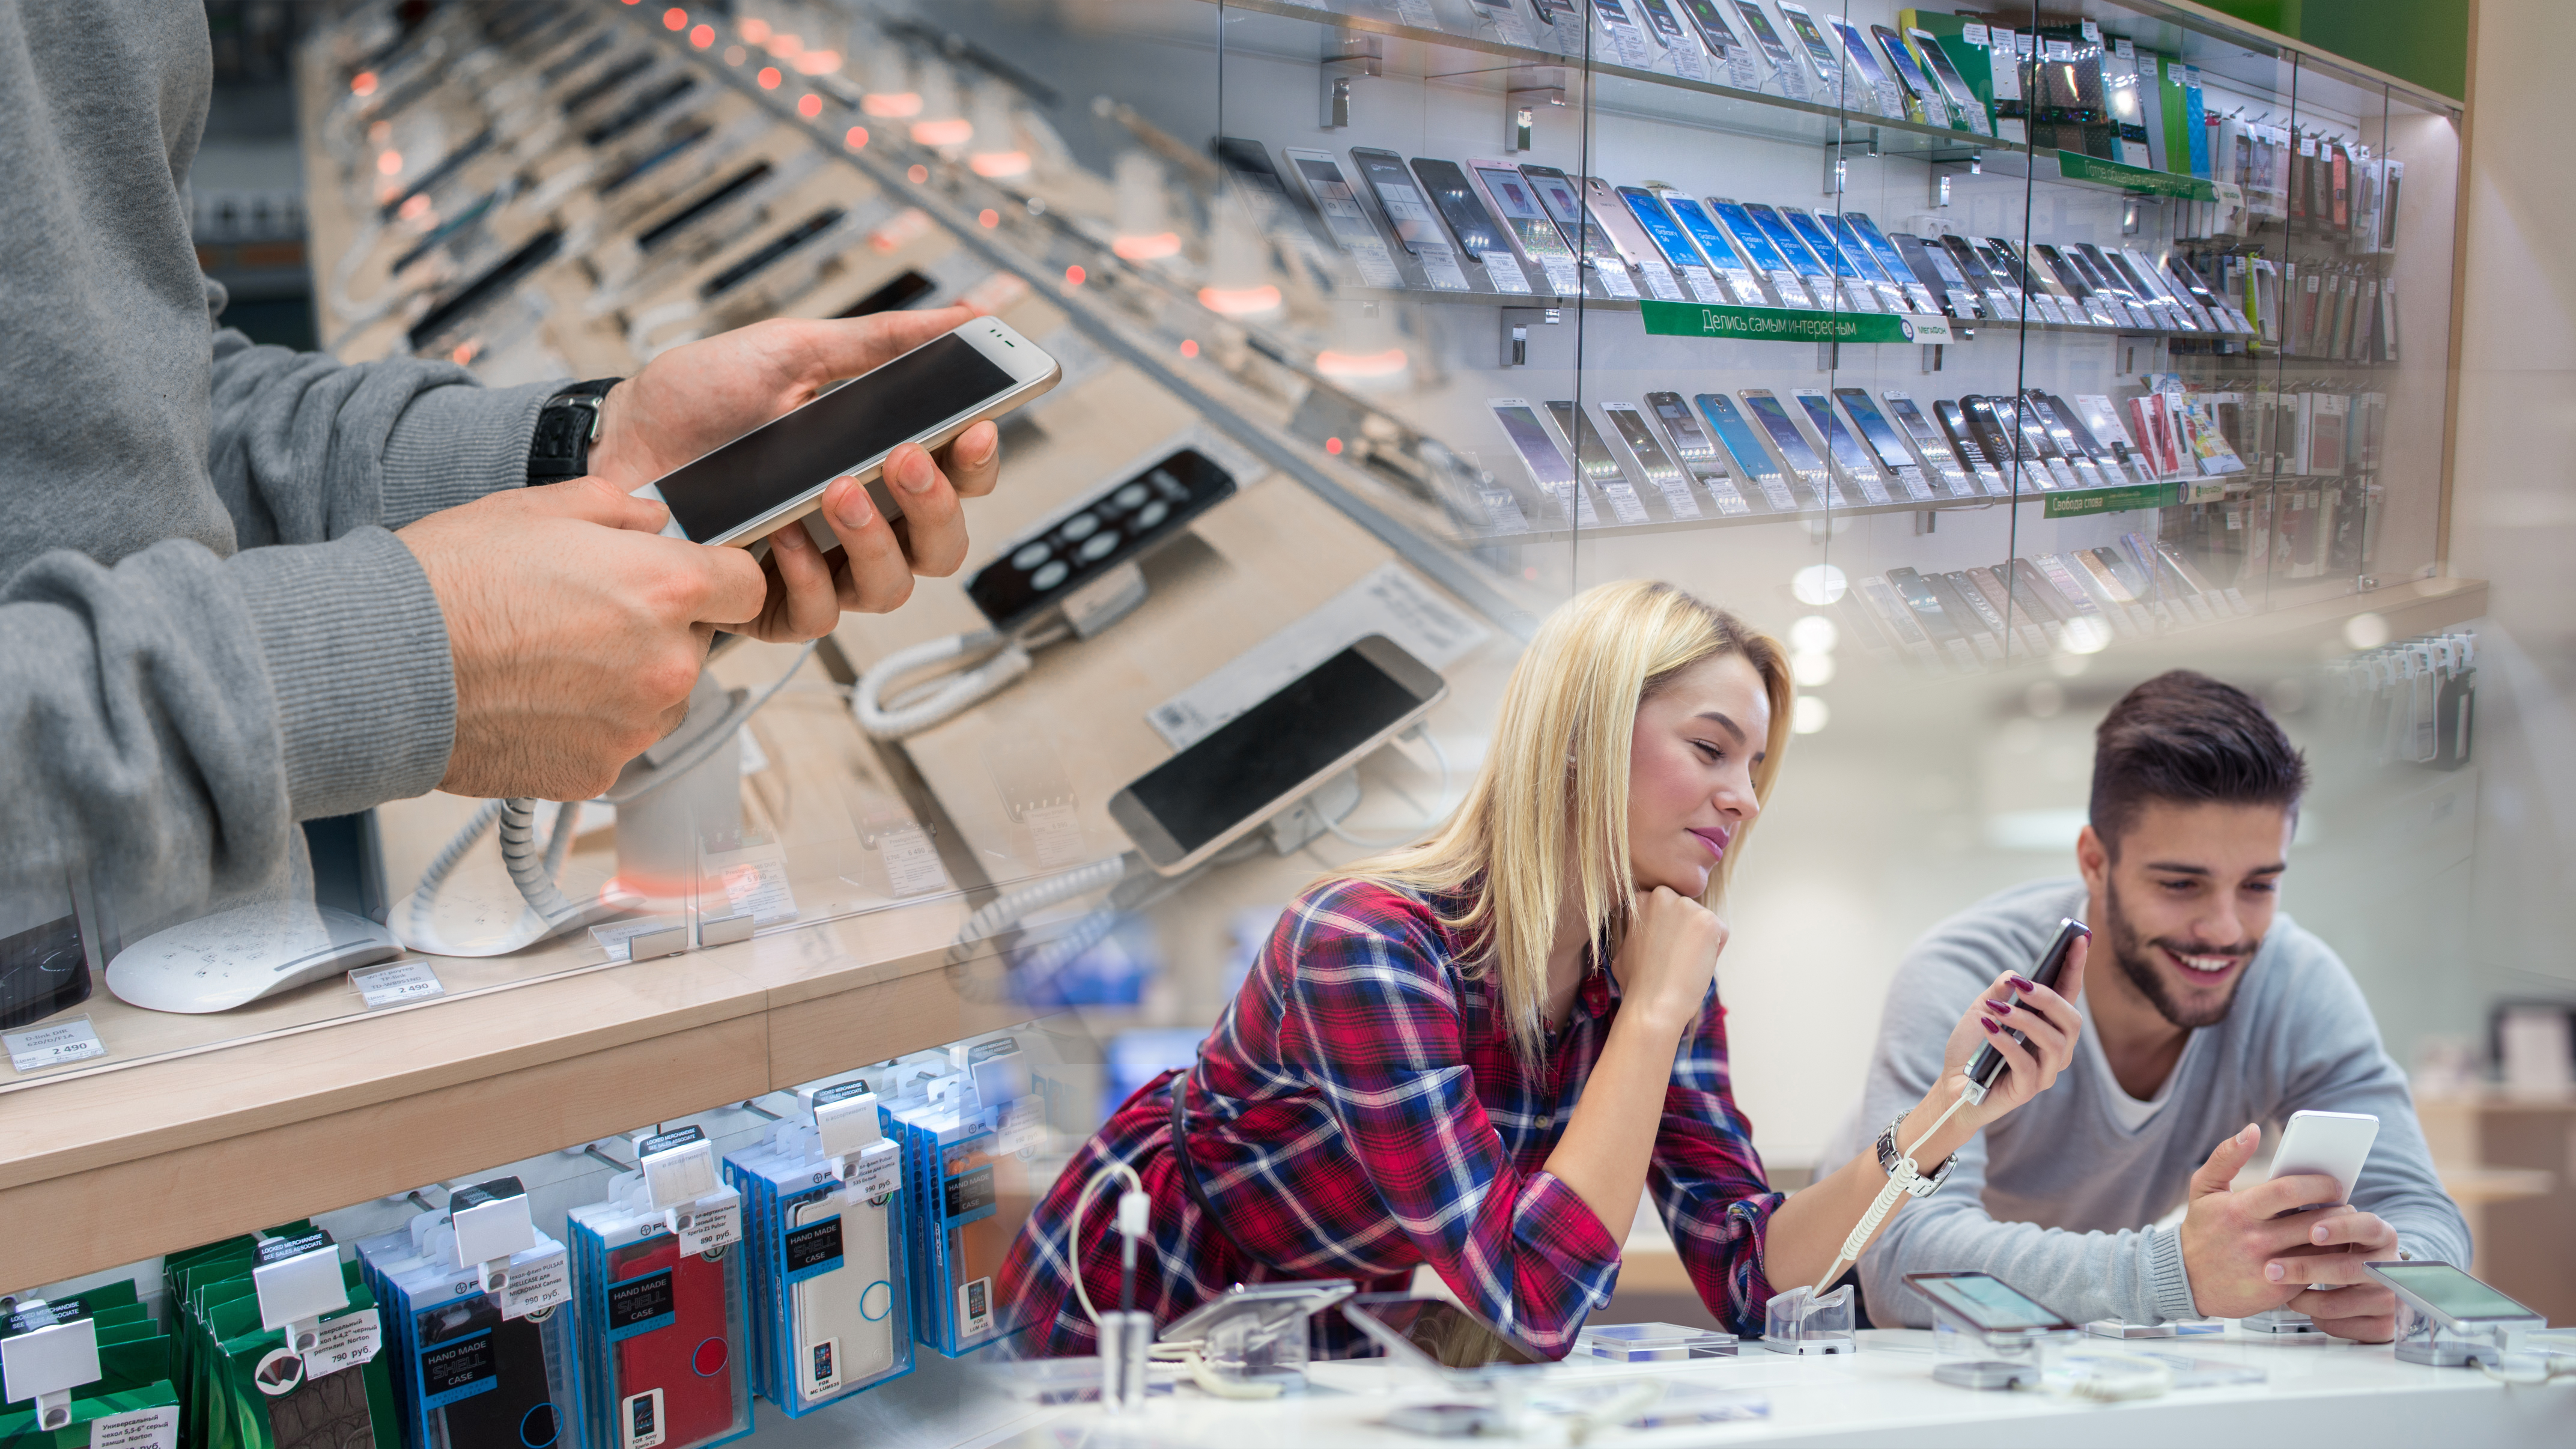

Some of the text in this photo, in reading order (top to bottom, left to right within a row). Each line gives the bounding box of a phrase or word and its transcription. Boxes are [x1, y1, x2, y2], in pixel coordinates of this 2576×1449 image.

[1703, 309, 1856, 339] Делись самым интересным
[2053, 496, 2082, 512] Свобода
[2084, 497, 2103, 508] слова
[387, 966, 415, 974] роутер
[380, 973, 407, 982] TP-link
[409, 983, 429, 991] 490
[25, 1033, 52, 1042] D-link
[64, 1043, 88, 1053] 490
[15, 1056, 39, 1065] Цена:
[646, 1128, 696, 1146] LOCKED MERCHANDISE
[672, 1134, 696, 1144] ASSOCIATE
[859, 1160, 879, 1169] ол-флип
[865, 1184, 876, 1194] 990
[949, 1173, 989, 1191] HAND MADE
[962, 1198, 980, 1209] CASE
[695, 1203, 737, 1219] ол-вертикальны
[714, 1215, 727, 1223] Sony
[687, 1227, 703, 1236] Xperia
[700, 1235, 713, 1244] 890
[715, 1230, 731, 1241] руб.
[790, 1224, 837, 1245] HAND MADE
[261, 1233, 323, 1255] LOCKED MERCHANDISE
[276, 1248, 293, 1258] SALES
[293, 1240, 323, 1253] ASSOCIATE
[794, 1236, 837, 1259] SHELL
[806, 1251, 825, 1263] CASE
[542, 1260, 564, 1271] PULSAR
[539, 1273, 550, 1281] для
[509, 1278, 562, 1297] MICROMAX Canvas
[614, 1278, 667, 1301] HAND MADE
[524, 1295, 538, 1306] 990
[542, 1289, 560, 1301] руб.
[618, 1290, 666, 1314] SHELL
[11, 1301, 80, 1323] LOCKED MERCHANDISE
[28, 1317, 45, 1326] SALES
[46, 1308, 79, 1320] ASSOCIATE
[631, 1307, 654, 1320] CASE
[320, 1318, 363, 1336] иверсальный
[353, 1324, 378, 1334] черный
[314, 1335, 369, 1356] рептилия Norton
[428, 1340, 487, 1365] HAND MADE
[332, 1345, 371, 1363] 790 руб.
[433, 1353, 486, 1380] SHELL
[448, 1372, 473, 1385] CASE
[819, 1382, 840, 1392] LUM535
[103, 1415, 159, 1430] Универсальный
[102, 1430, 123, 1439] чехол
[146, 1421, 169, 1430] серый
[102, 1433, 152, 1447] замша Norton
[645, 1433, 657, 1442] Sony
